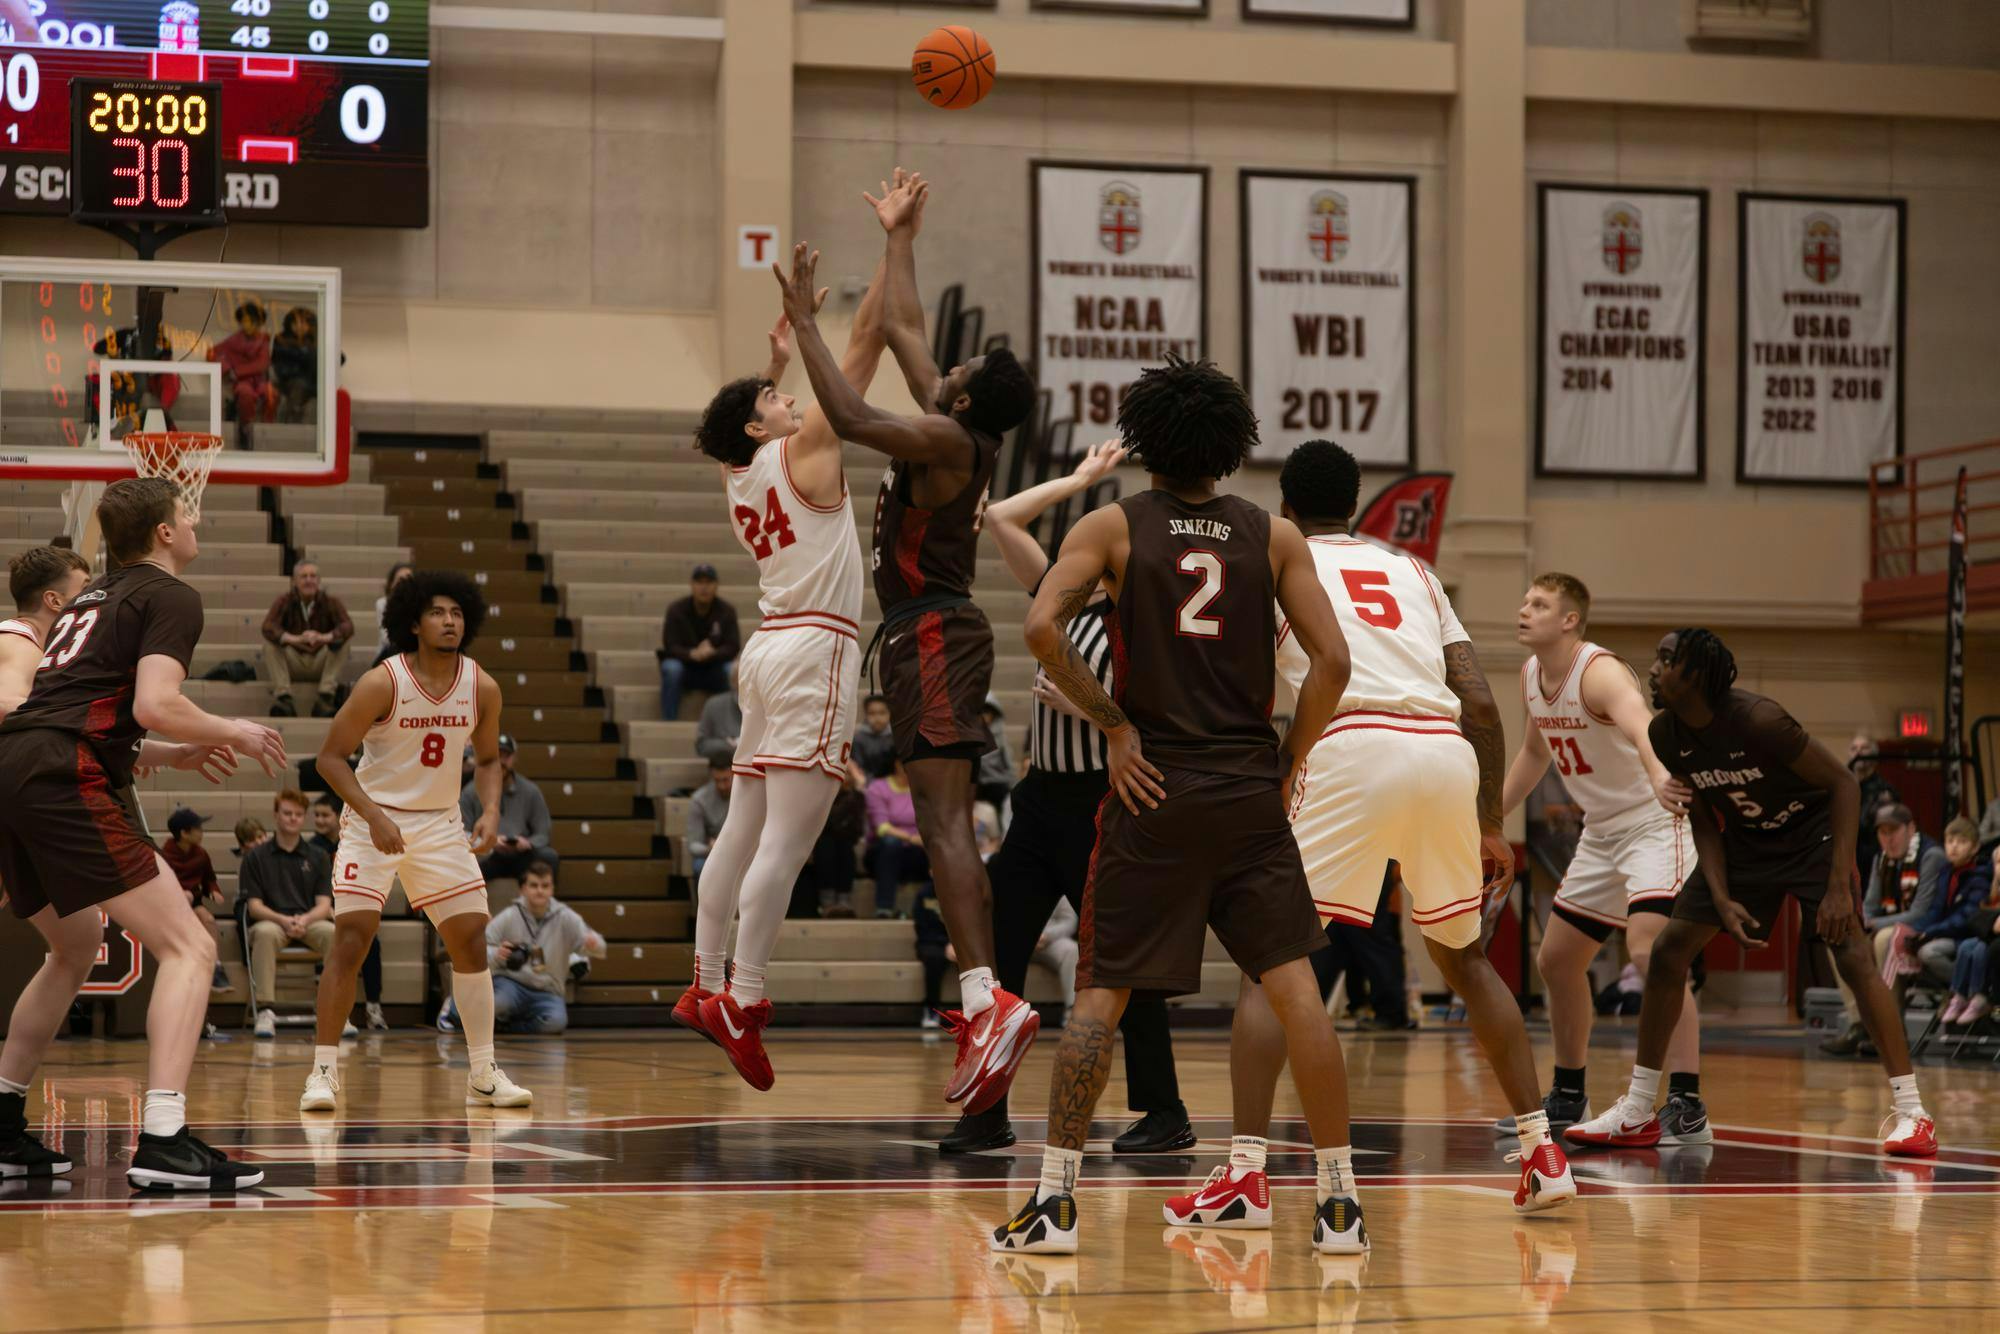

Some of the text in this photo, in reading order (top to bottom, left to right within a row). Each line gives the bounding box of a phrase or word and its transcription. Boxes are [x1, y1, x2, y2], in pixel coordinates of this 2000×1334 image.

[231, 0, 389, 23] 40 0 0
[231, 26, 389, 55] 45 0 0
[89, 92, 206, 135] 20:00
[340, 85, 386, 144] 0
[6, 124, 18, 143] 1
[112, 138, 189, 207] 30
[745, 232, 773, 262] T
[1111, 263, 1194, 279] BASKETBALL
[1320, 271, 1400, 287] BASKETBALL
[1076, 296, 1164, 332] NCAA
[1595, 306, 1650, 331] ECAC
[1793, 314, 1851, 338] USAG
[1047, 335, 1196, 361] TOURNAMENT
[1293, 314, 1365, 358] WBI
[1560, 333, 1685, 359] CHAMPIONS
[1754, 343, 1891, 368] TEAM FINALIST
[1562, 367, 1613, 391] 2014
[1766, 376, 1814, 398] 2013
[1069, 382, 1132, 424] 19
[1281, 389, 1380, 432] 2017
[1763, 408, 1816, 431] 2022
[734, 486, 797, 561] 24
[1169, 518, 1232, 541] JENKINS
[1176, 548, 1226, 640] 2
[1340, 569, 1403, 631] 5
[38, 606, 99, 671] 23
[399, 716, 469, 728] CORNELL
[1534, 717, 1588, 729] CORNELL
[420, 732, 446, 769] 8
[1548, 736, 1594, 776] 31
[1690, 767, 1764, 789] BROWN
[1728, 791, 1762, 818] 5
[344, 863, 358, 880] C
